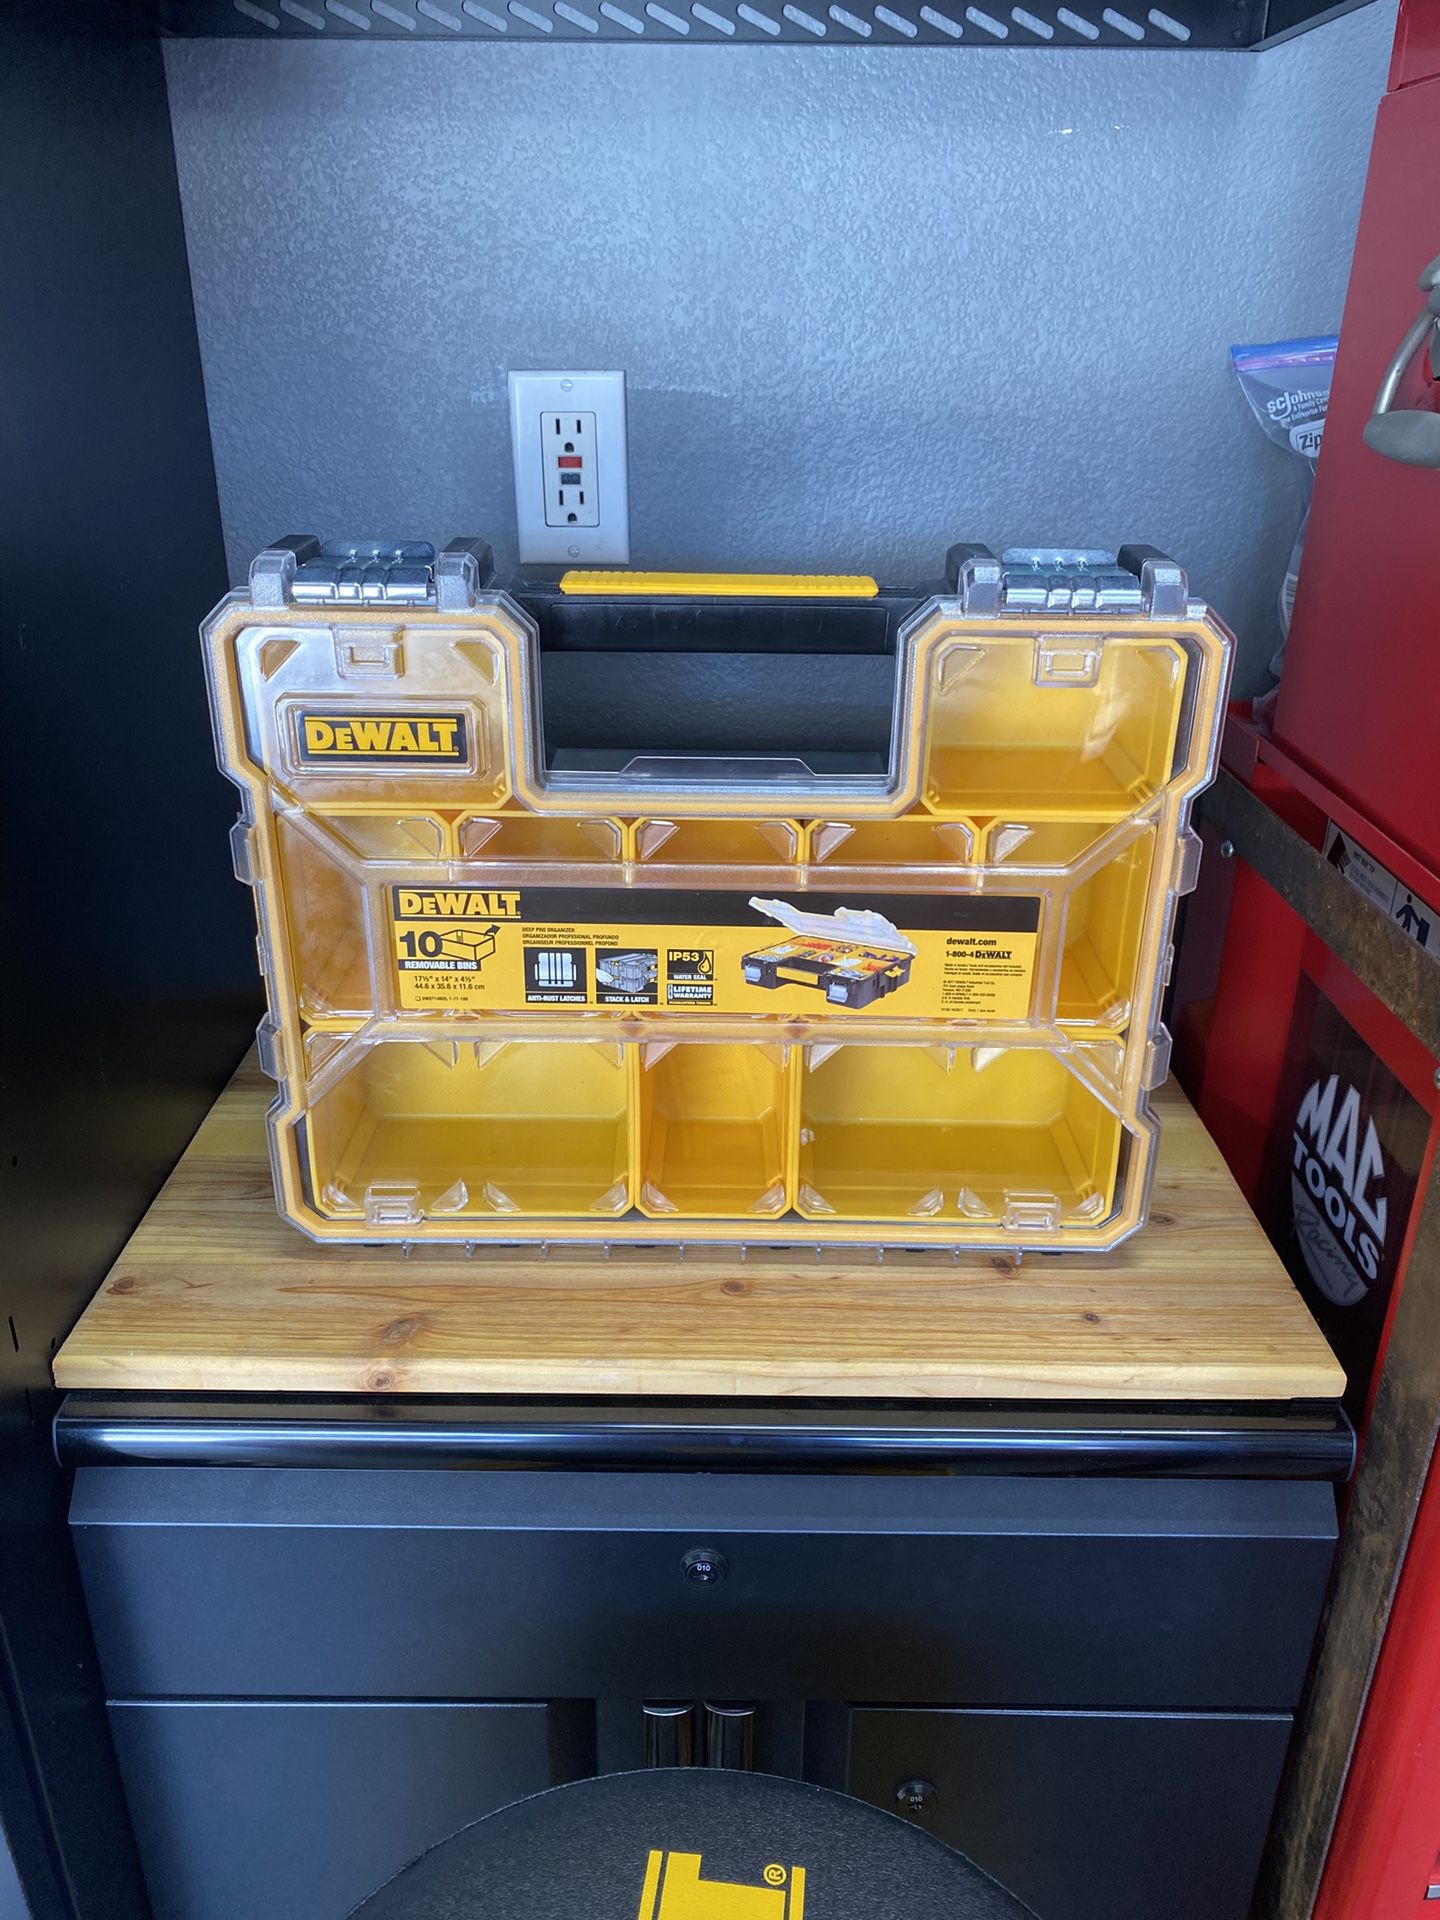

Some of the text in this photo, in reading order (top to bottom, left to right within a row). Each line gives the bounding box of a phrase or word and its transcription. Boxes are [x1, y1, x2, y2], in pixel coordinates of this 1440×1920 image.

[400, 930, 443, 958] 10
[946, 937, 997, 946] dewalt.com
[669, 951, 700, 962] IP53
[405, 961, 477, 970] REMOVABLE BINS
[1296, 1074, 1387, 1247] MAC
[1293, 1130, 1380, 1280] TOOLS
[697, 1564, 711, 1572] 010
